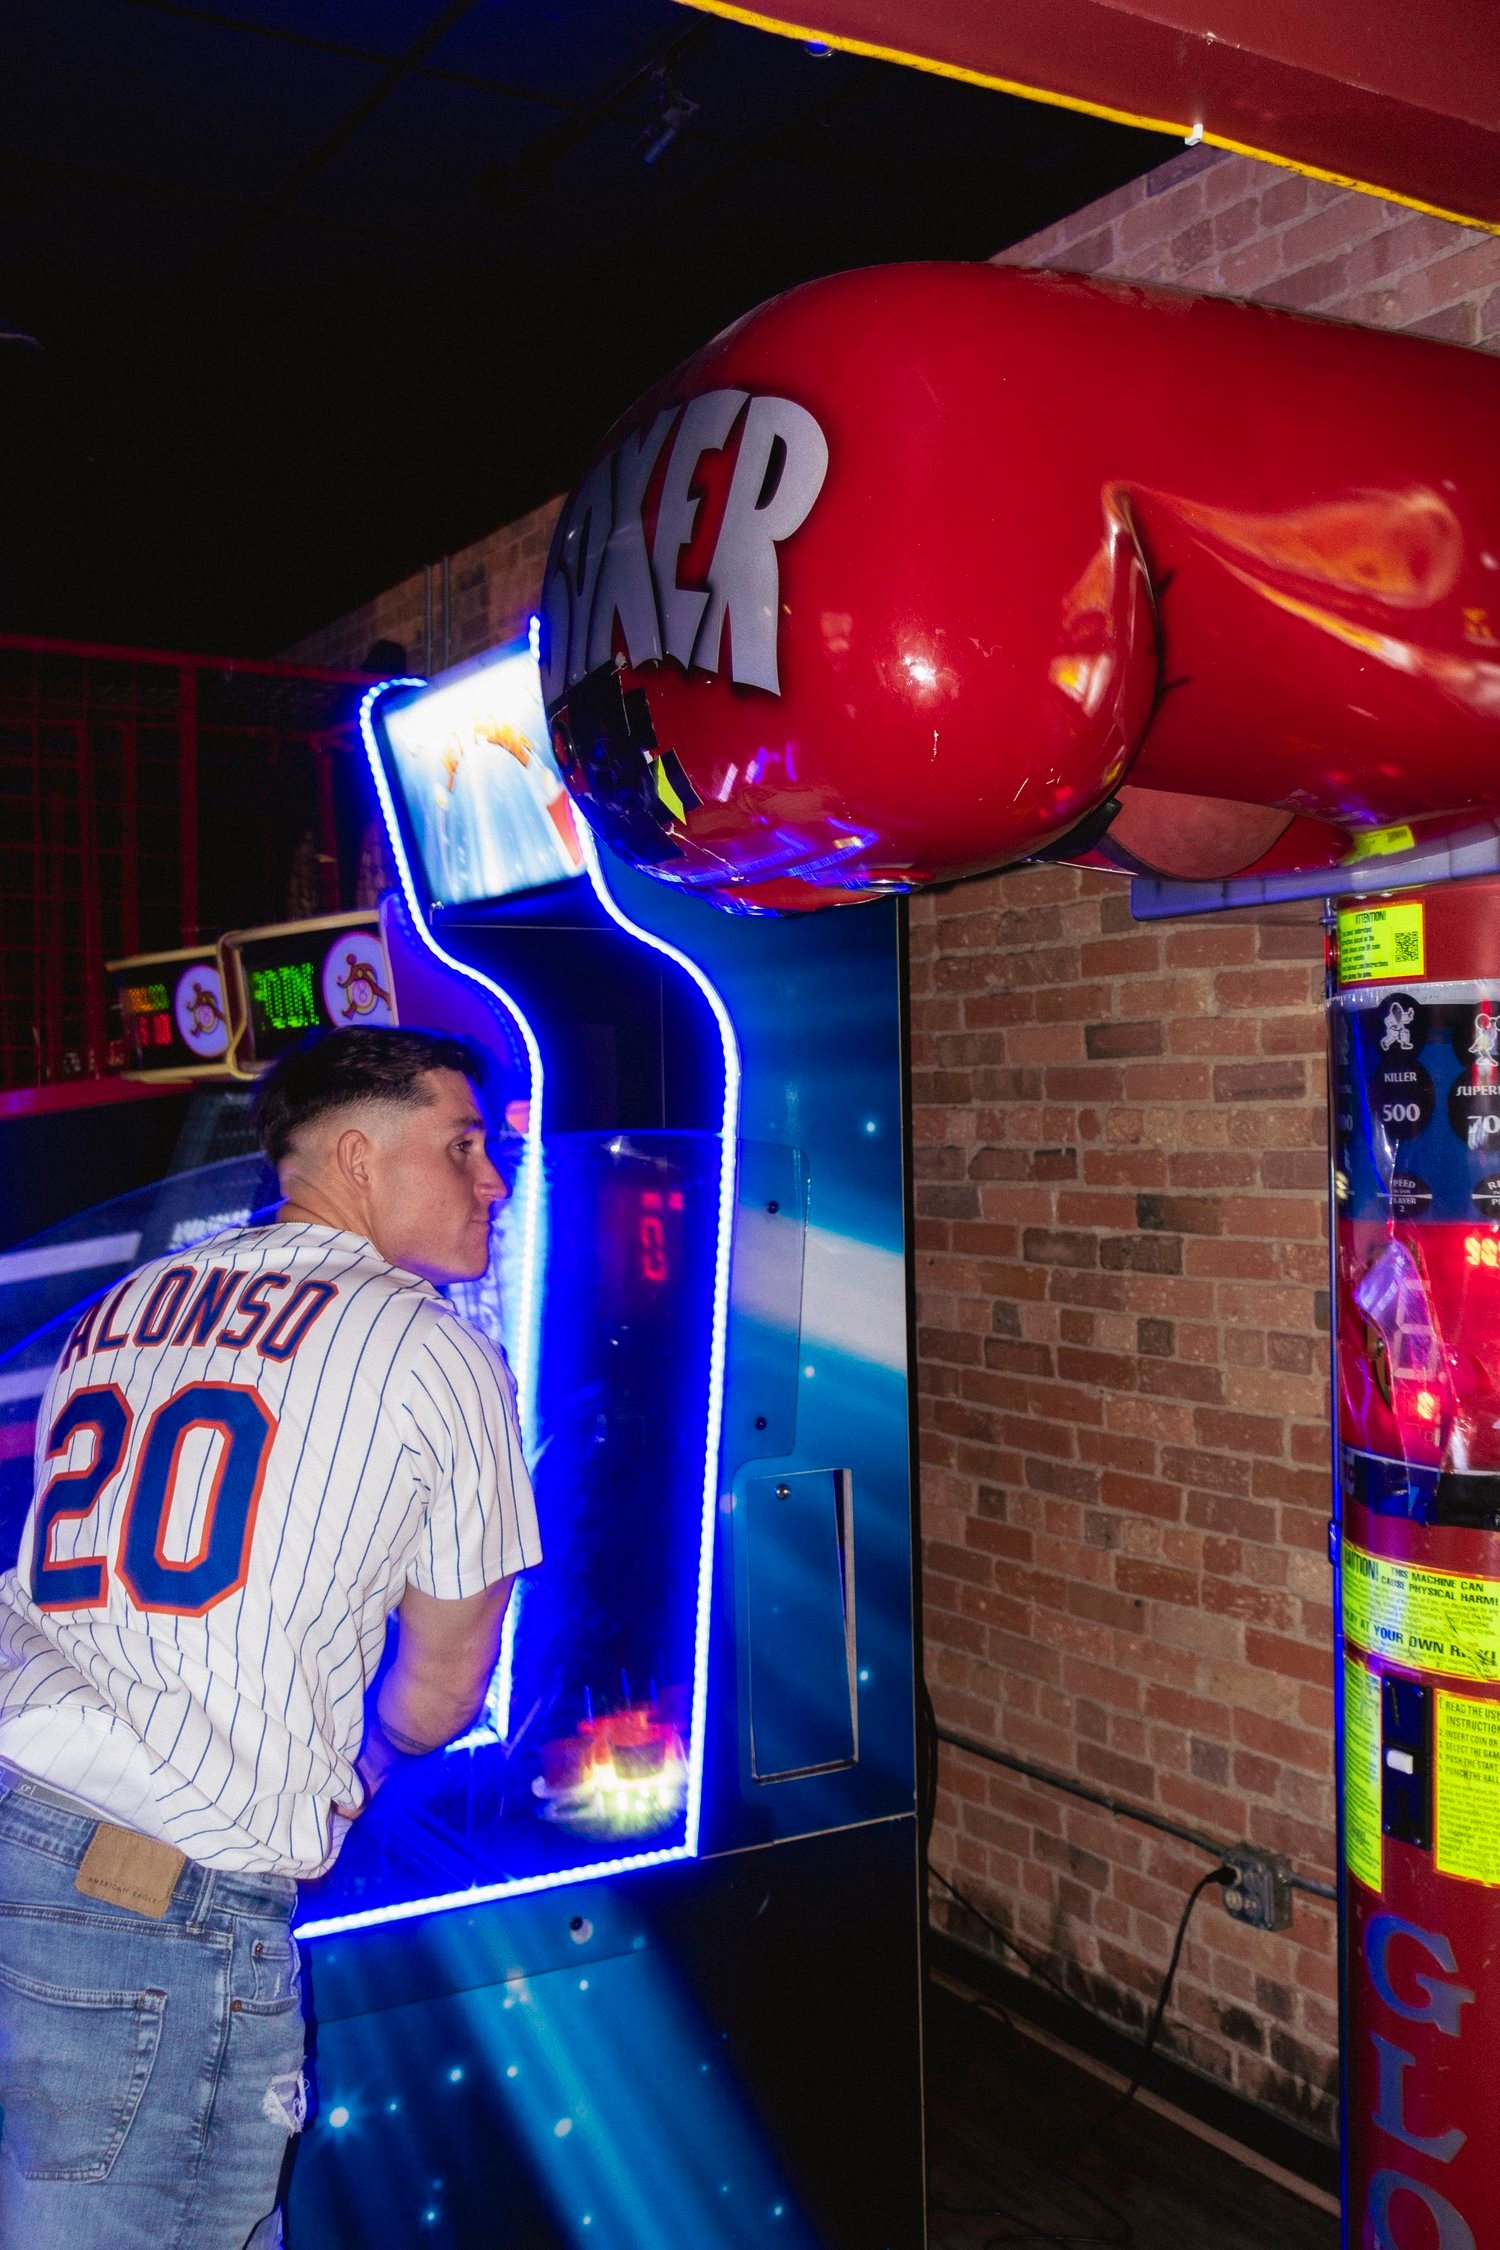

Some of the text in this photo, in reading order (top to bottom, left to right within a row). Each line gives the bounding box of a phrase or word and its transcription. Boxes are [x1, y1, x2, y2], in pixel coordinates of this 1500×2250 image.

[1384, 1071, 1417, 1083] KILLER
[1455, 1085, 1500, 1097] SUPER
[1382, 1103, 1421, 1122] 500
[1391, 1179, 1416, 1189] PEED
[1391, 1197, 1417, 1205] LAYER
[59, 1265, 339, 1374] ALONSO
[30, 1380, 279, 1618] 20
[1391, 1566, 1484, 1592] THIS MACHINE CAN
[1381, 1576, 1498, 1606] CAUSE PHYSICAL HARM!
[1360, 1617, 1370, 1633] AT
[1373, 1624, 1404, 1645] YOUR
[1409, 1636, 1444, 1654] OWN
[1445, 1701, 1466, 1714] READ
[1468, 1705, 1482, 1717] THE
[1445, 1730, 1469, 1743] INSERT
[1470, 1735, 1487, 1746] COIN
[1488, 1738, 1498, 1747] OR
[1445, 1742, 1468, 1754] SELECT
[1469, 1747, 1481, 1757] THE
[1476, 1761, 1498, 1772] START
[88, 1877, 129, 1895] AMERICAN
